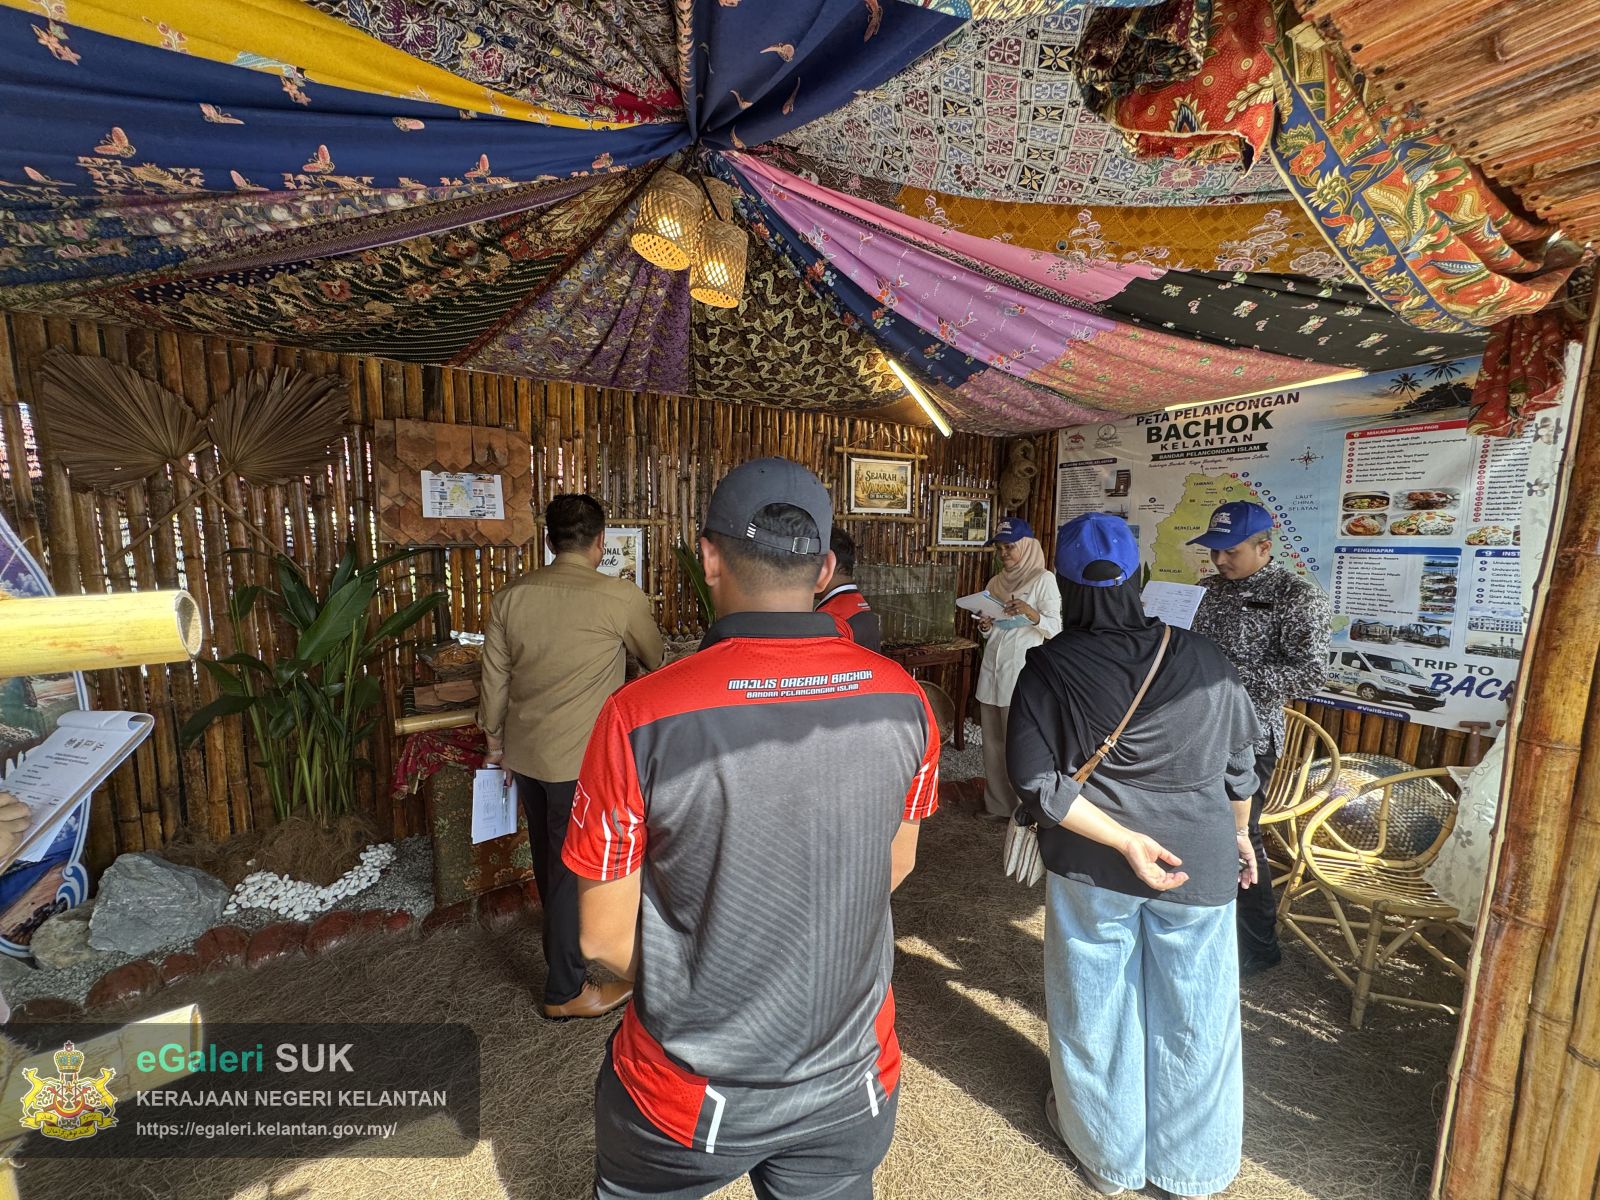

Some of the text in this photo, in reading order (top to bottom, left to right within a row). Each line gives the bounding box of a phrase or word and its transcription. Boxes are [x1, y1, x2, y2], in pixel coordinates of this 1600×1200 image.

[1136, 392, 1300, 426] PETA PELANCONGAN
[1147, 410, 1274, 444] BACHOK
[1160, 434, 1253, 452] KELANTAN
[1159, 452, 1184, 460] BANDAR
[1186, 448, 1236, 458] PELANCONGAN
[865, 470, 897, 481] SEJARAH
[1412, 658, 1494, 676] TRIP TO
[728, 670, 873, 690] MAJLIS DAERAH BACHOK
[746, 683, 859, 699] BANDAR PELANCONGAN ISLAM
